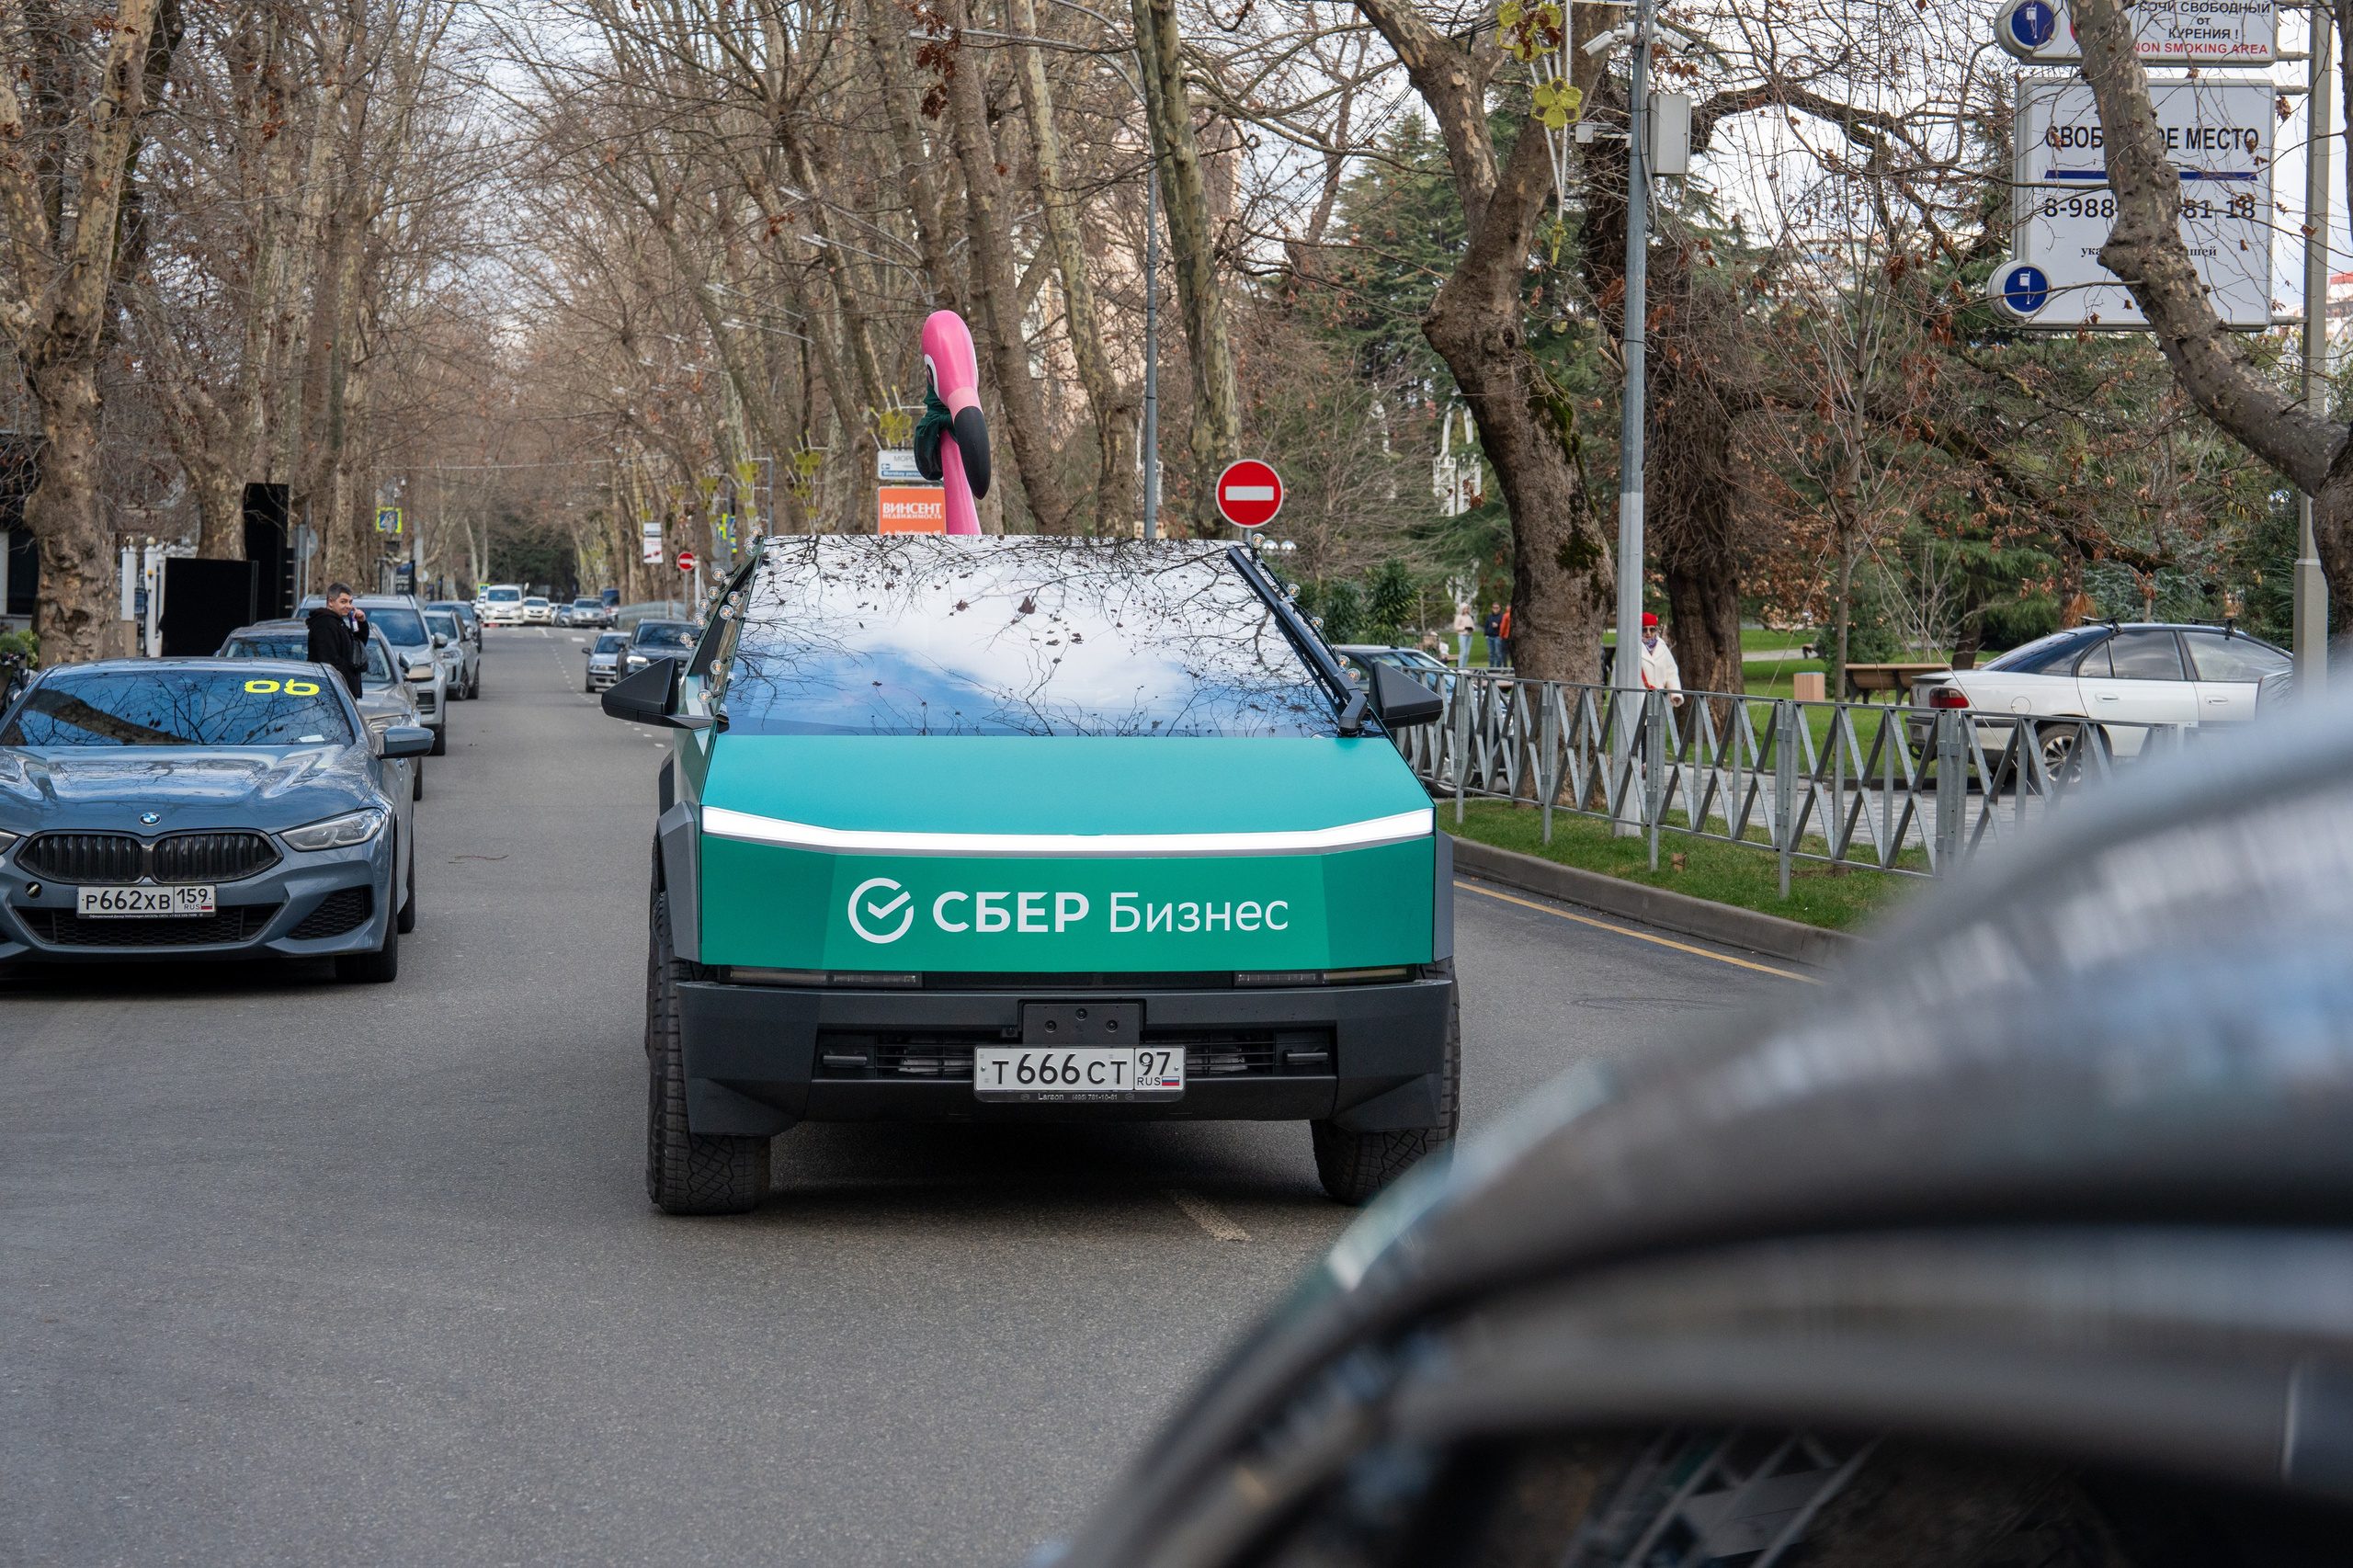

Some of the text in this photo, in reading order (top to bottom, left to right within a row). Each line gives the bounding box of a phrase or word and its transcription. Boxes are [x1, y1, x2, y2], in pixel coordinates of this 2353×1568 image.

[2181, 1, 2270, 15] СВОБОДНЫЙ
[2165, 43, 2227, 53] SMOKING
[2232, 44, 2268, 53] AREA
[2186, 127, 2258, 150] МЕСТО
[882, 503, 942, 514] ВИНСЕНТ
[85, 888, 208, 910] Р662ХВ 159
[932, 891, 1289, 933] СБЕР Бизнес
[992, 1051, 1171, 1085] Т666СТ 97
[1137, 1077, 1161, 1085] RUS
